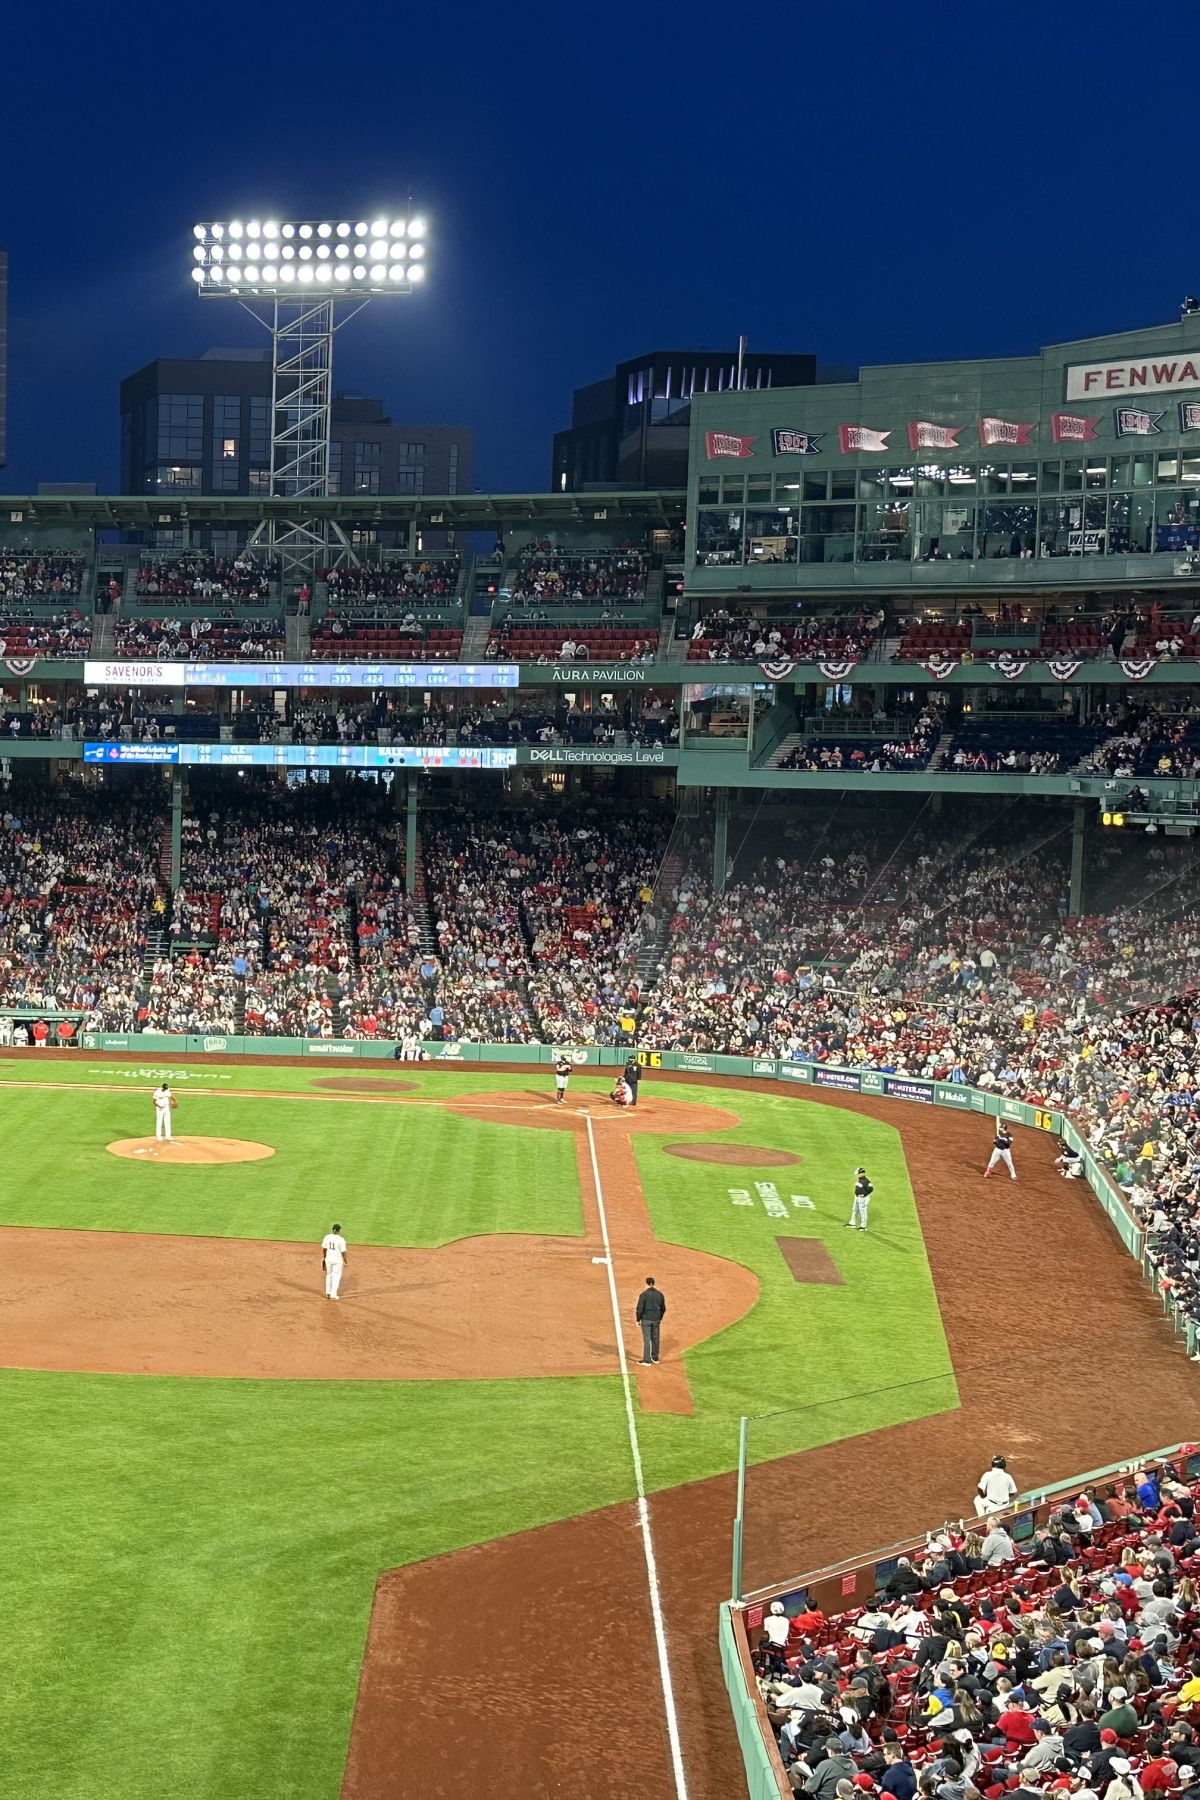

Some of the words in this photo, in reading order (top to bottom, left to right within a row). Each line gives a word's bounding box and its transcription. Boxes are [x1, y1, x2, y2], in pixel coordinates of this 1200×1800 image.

[106, 666, 162, 677] SAVENOR'S
[593, 670, 645, 680] PAVILION
[459, 748, 479, 757] OUT
[563, 750, 632, 764] Technologies
[636, 751, 664, 762] Level
[309, 1044, 354, 1053] smartwater
[638, 1052, 661, 1067] 06
[1035, 1110, 1051, 1130] 06
[915, 1620, 931, 1636] 45
